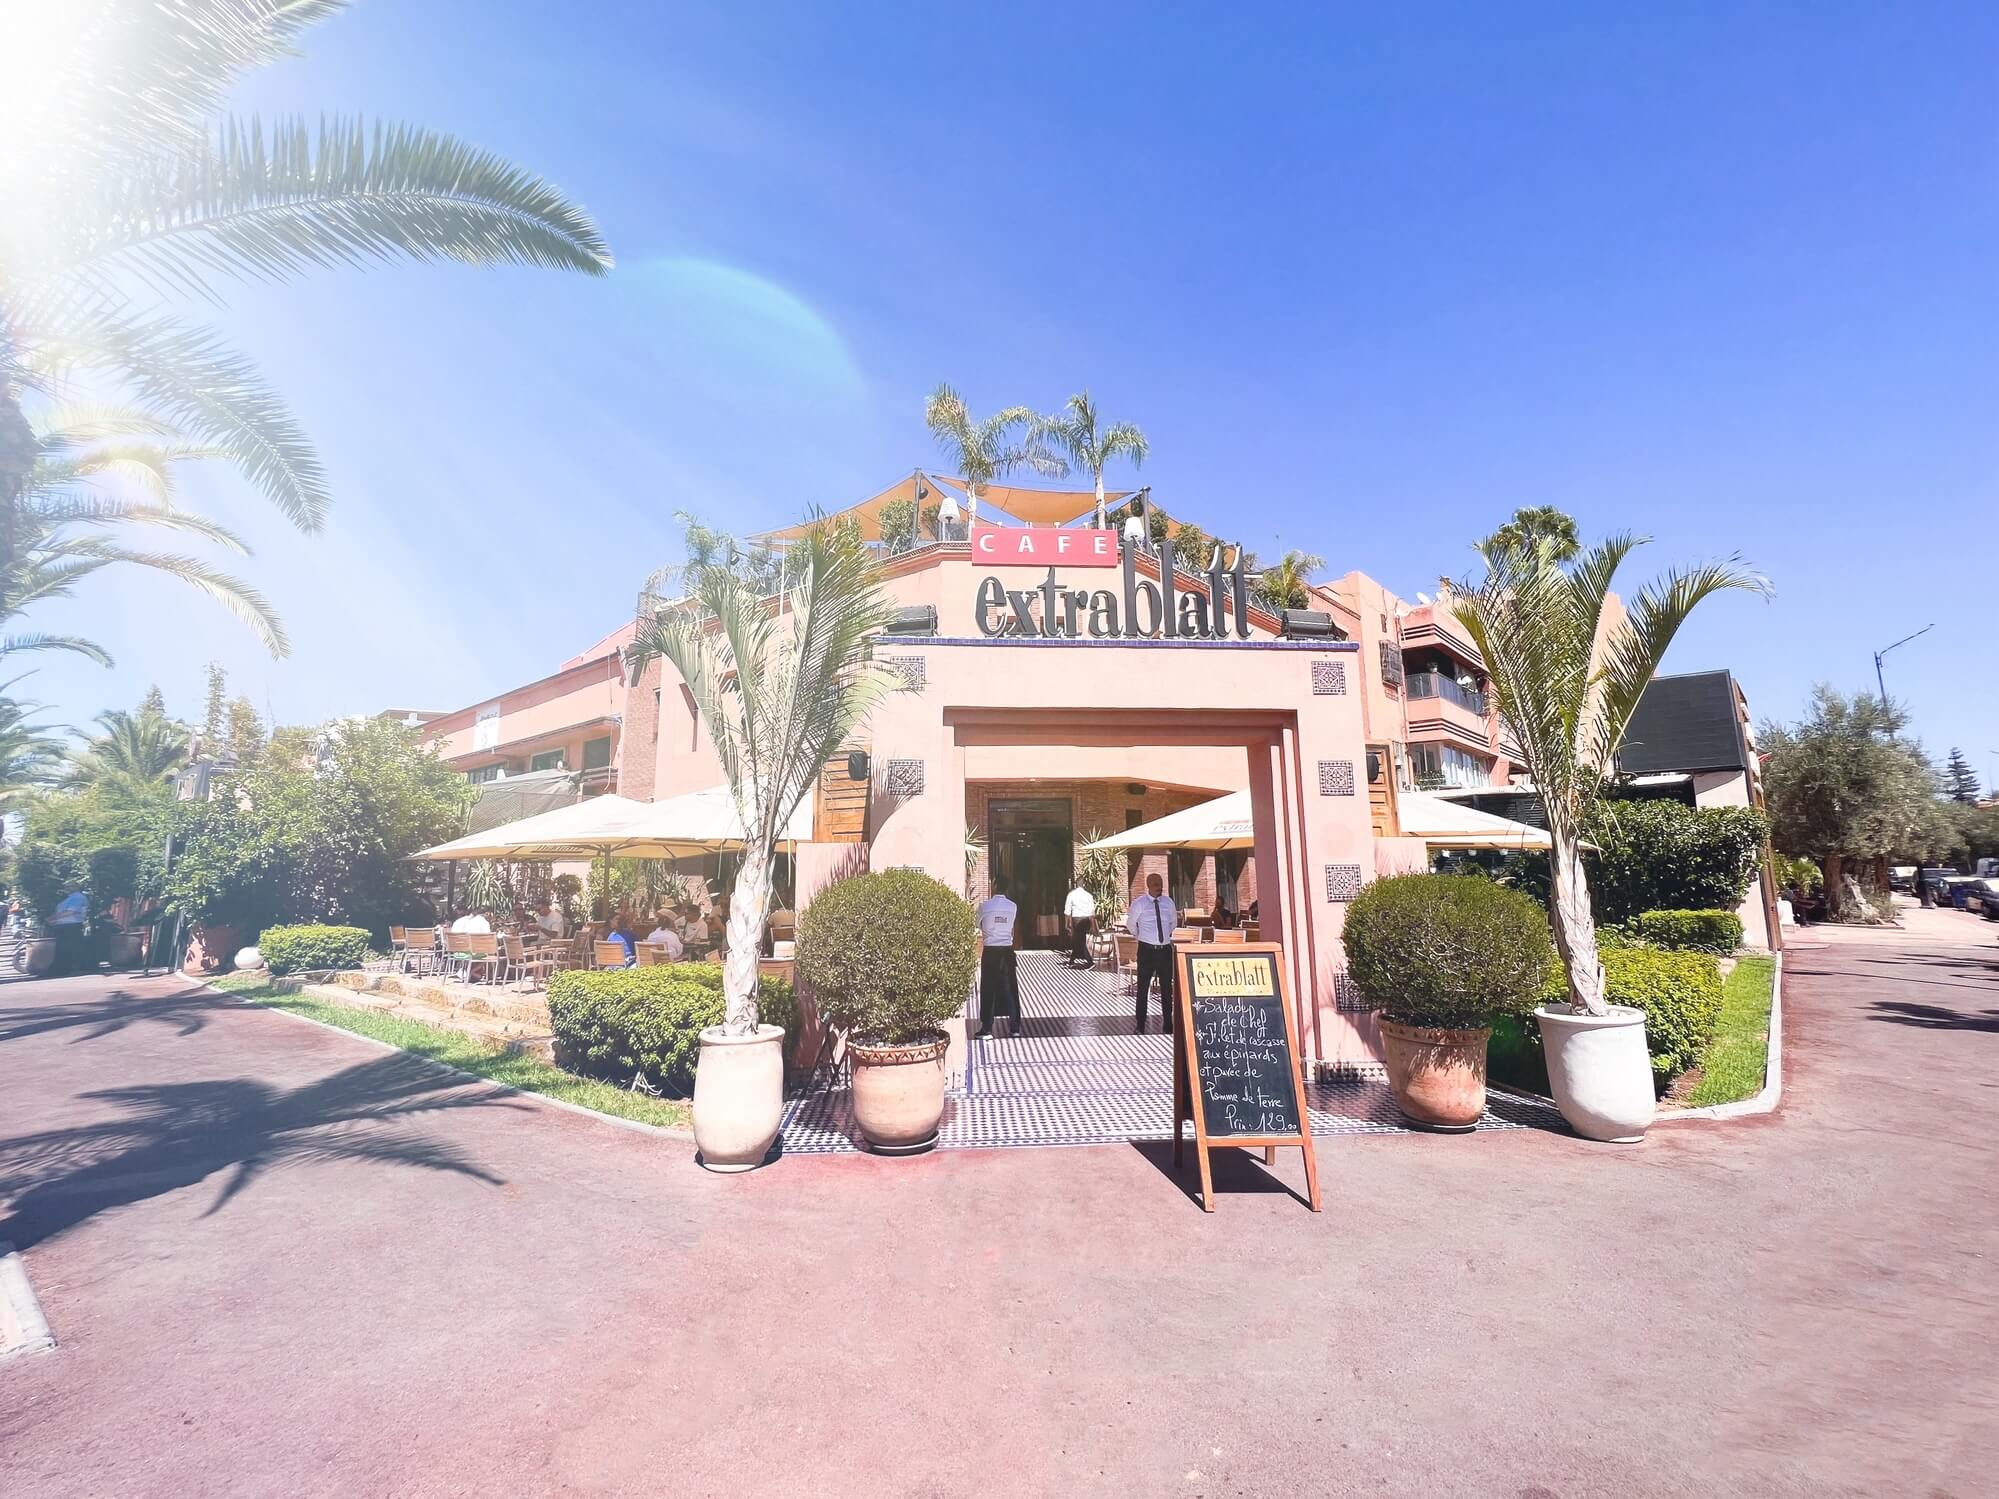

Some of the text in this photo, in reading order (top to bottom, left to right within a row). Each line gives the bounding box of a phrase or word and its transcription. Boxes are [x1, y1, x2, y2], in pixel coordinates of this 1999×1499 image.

[979, 534, 1108, 554] CAFE
[975, 541, 1254, 640] extrablatt
[1197, 961, 1268, 986] extrablatt
[1204, 997, 1249, 1014] Salade
[1240, 1004, 1268, 1037] Chef
[1203, 1044, 1278, 1067] aux épinards
[1200, 1061, 1212, 1077] et
